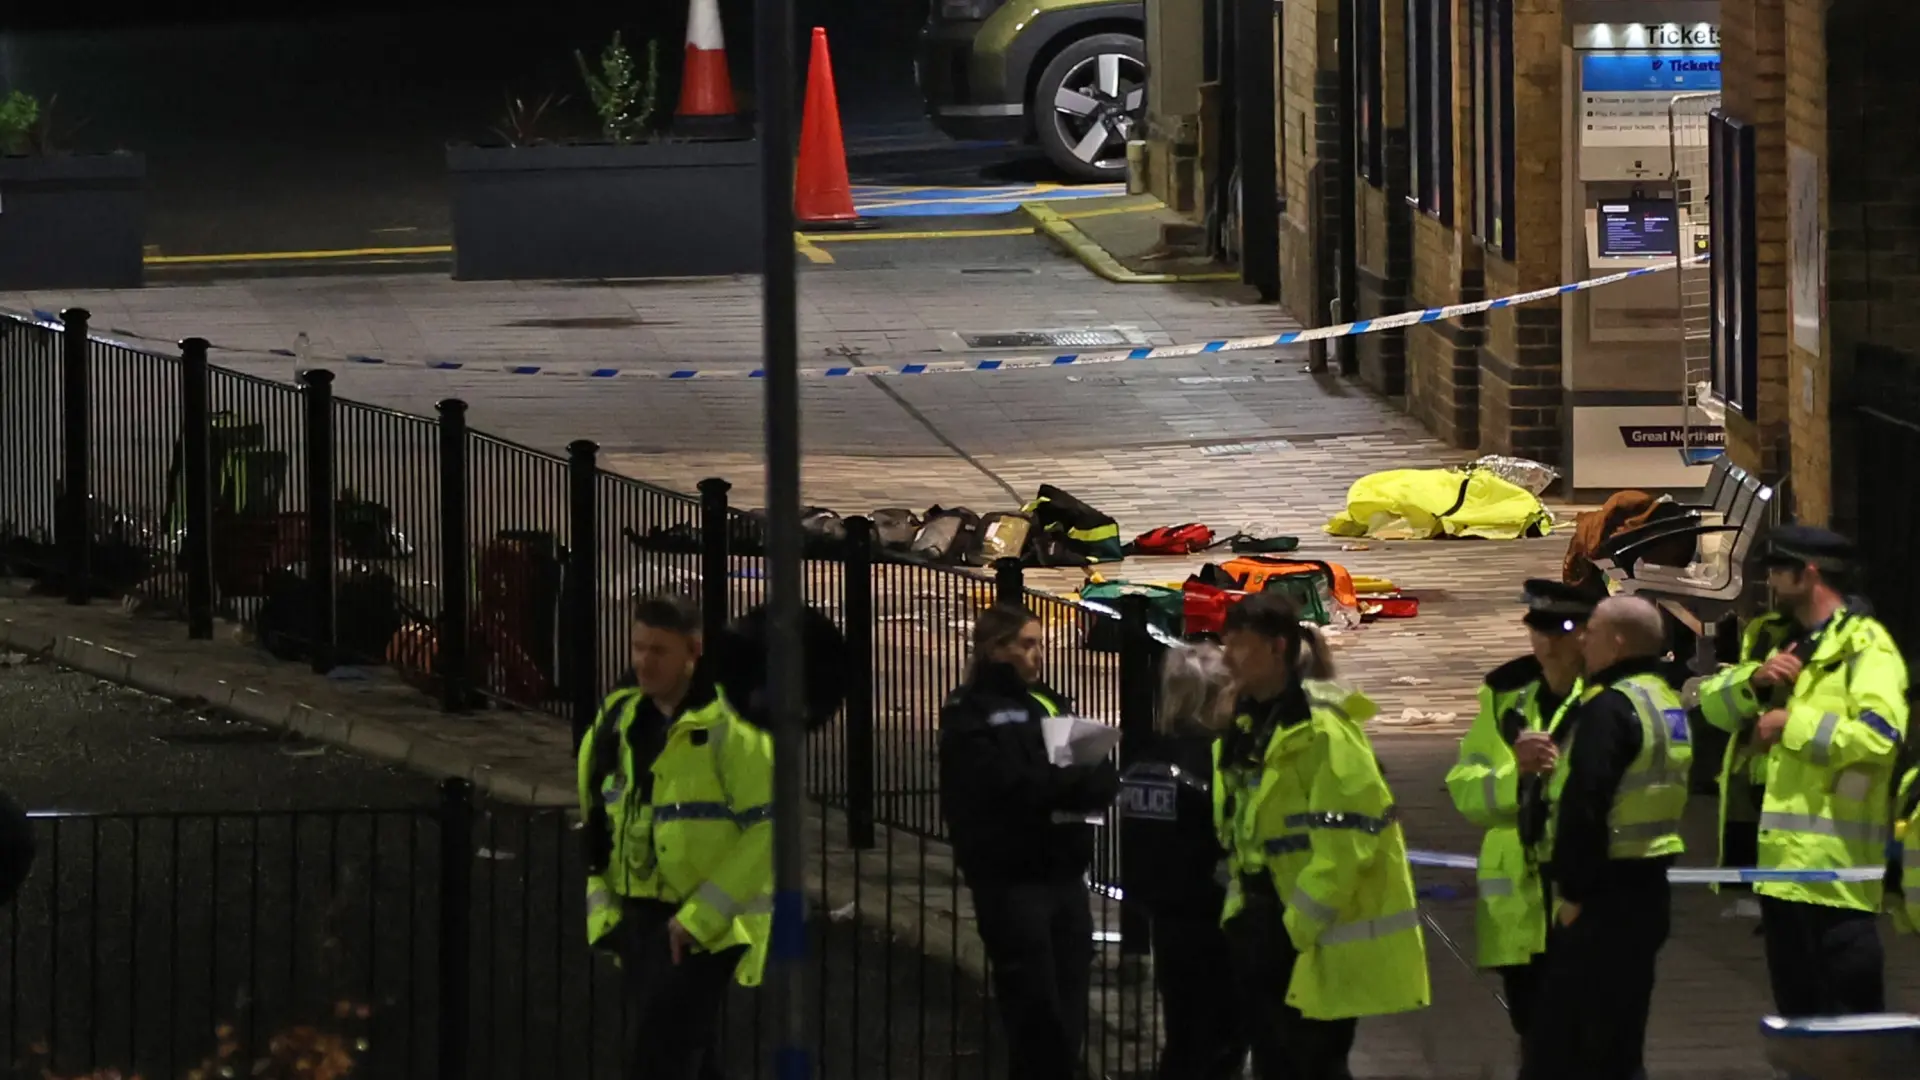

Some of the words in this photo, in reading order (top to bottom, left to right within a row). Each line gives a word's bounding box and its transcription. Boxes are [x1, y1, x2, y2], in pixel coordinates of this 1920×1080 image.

[1668, 60, 1720, 71] Tickets
[1632, 430, 1667, 442] Great
[1123, 787, 1172, 813] POLICE
